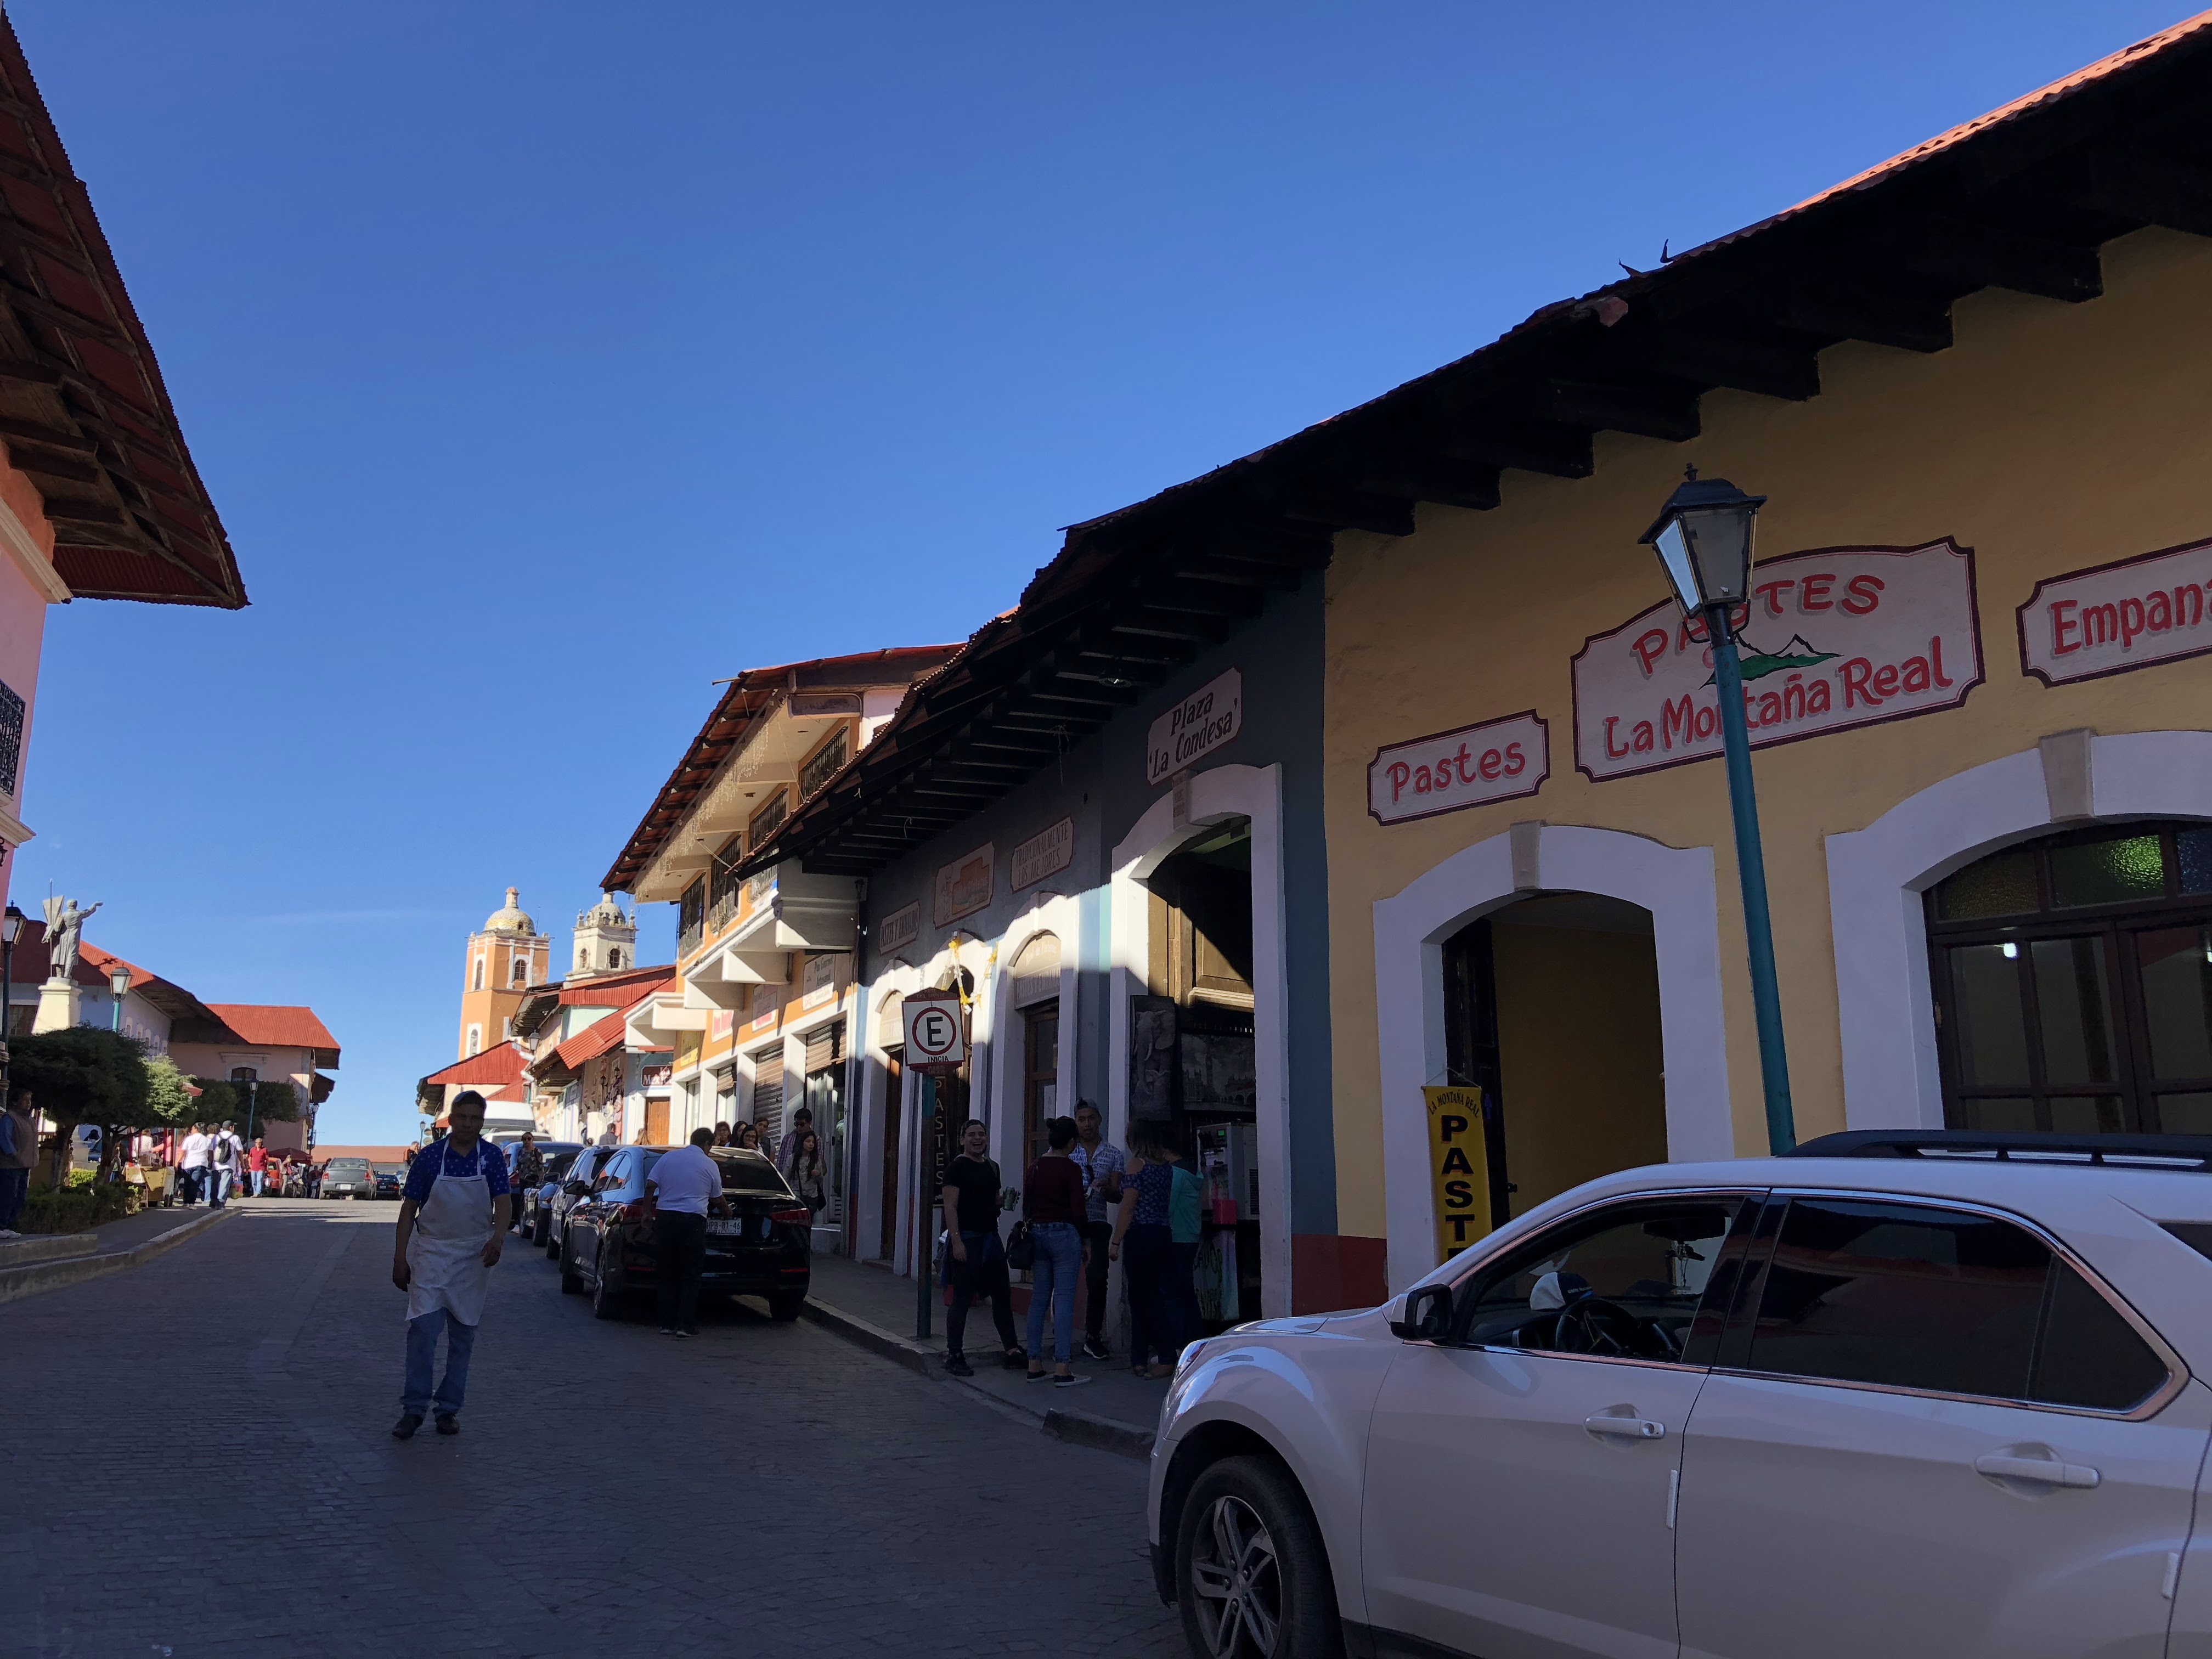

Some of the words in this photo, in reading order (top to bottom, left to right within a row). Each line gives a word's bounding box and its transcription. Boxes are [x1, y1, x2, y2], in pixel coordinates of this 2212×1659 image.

[2048, 579, 2212, 656] Empan
[1170, 692, 1214, 737] Plaza
[1604, 716, 1654, 758] La
[1838, 635, 1954, 709] Real
[1385, 742, 1526, 803] Pastes
[1015, 821, 1069, 868] TRADICIONALMENTE
[1018, 865, 1028, 887] LOS
[1031, 848, 1060, 880] MEJORES
[926, 1016, 945, 1047] E
[928, 1055, 949, 1063] INICIA
[1428, 1101, 1437, 1115] LA
[1437, 1088, 1464, 1107] MONTAÑA
[1465, 1095, 1481, 1119] REAL
[934, 1080, 944, 1185] PASTES
